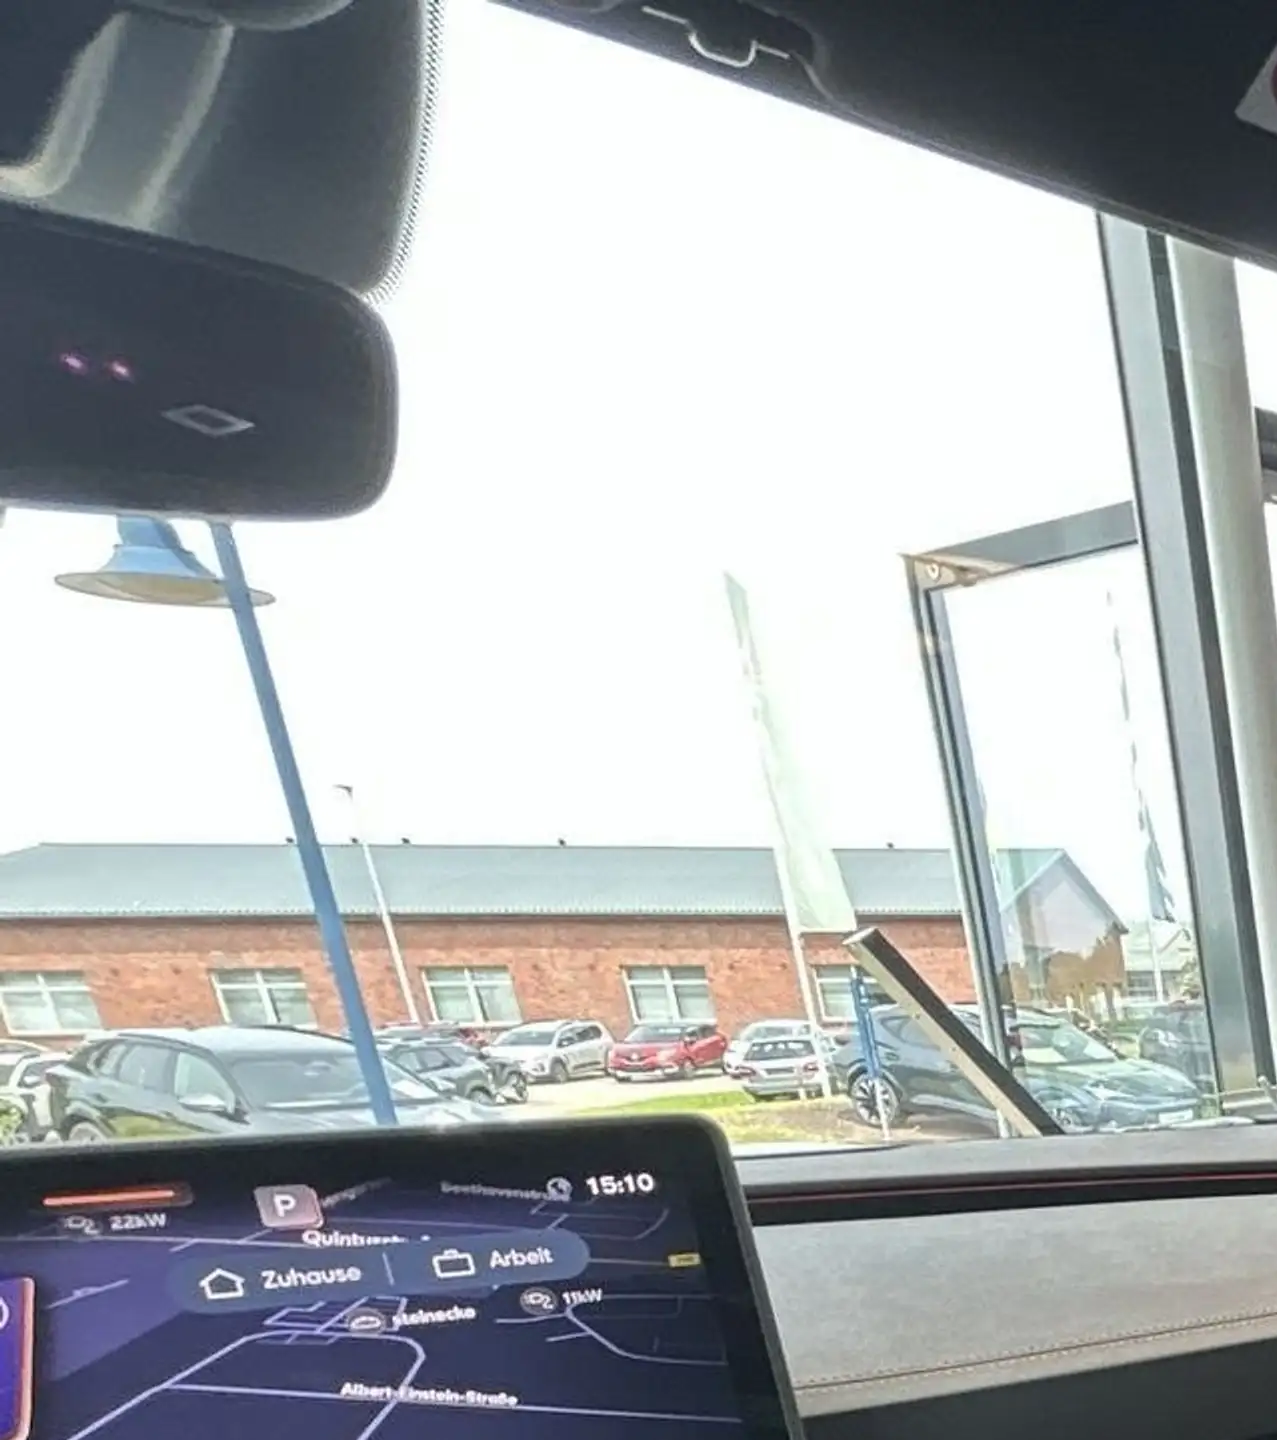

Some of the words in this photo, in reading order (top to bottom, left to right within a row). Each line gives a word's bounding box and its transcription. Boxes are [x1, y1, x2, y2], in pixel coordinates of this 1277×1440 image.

[585, 1172, 655, 1196] 15:10
[272, 1194, 296, 1218] P
[489, 1246, 554, 1270] Arbeit
[260, 1265, 362, 1290] Zuhause
